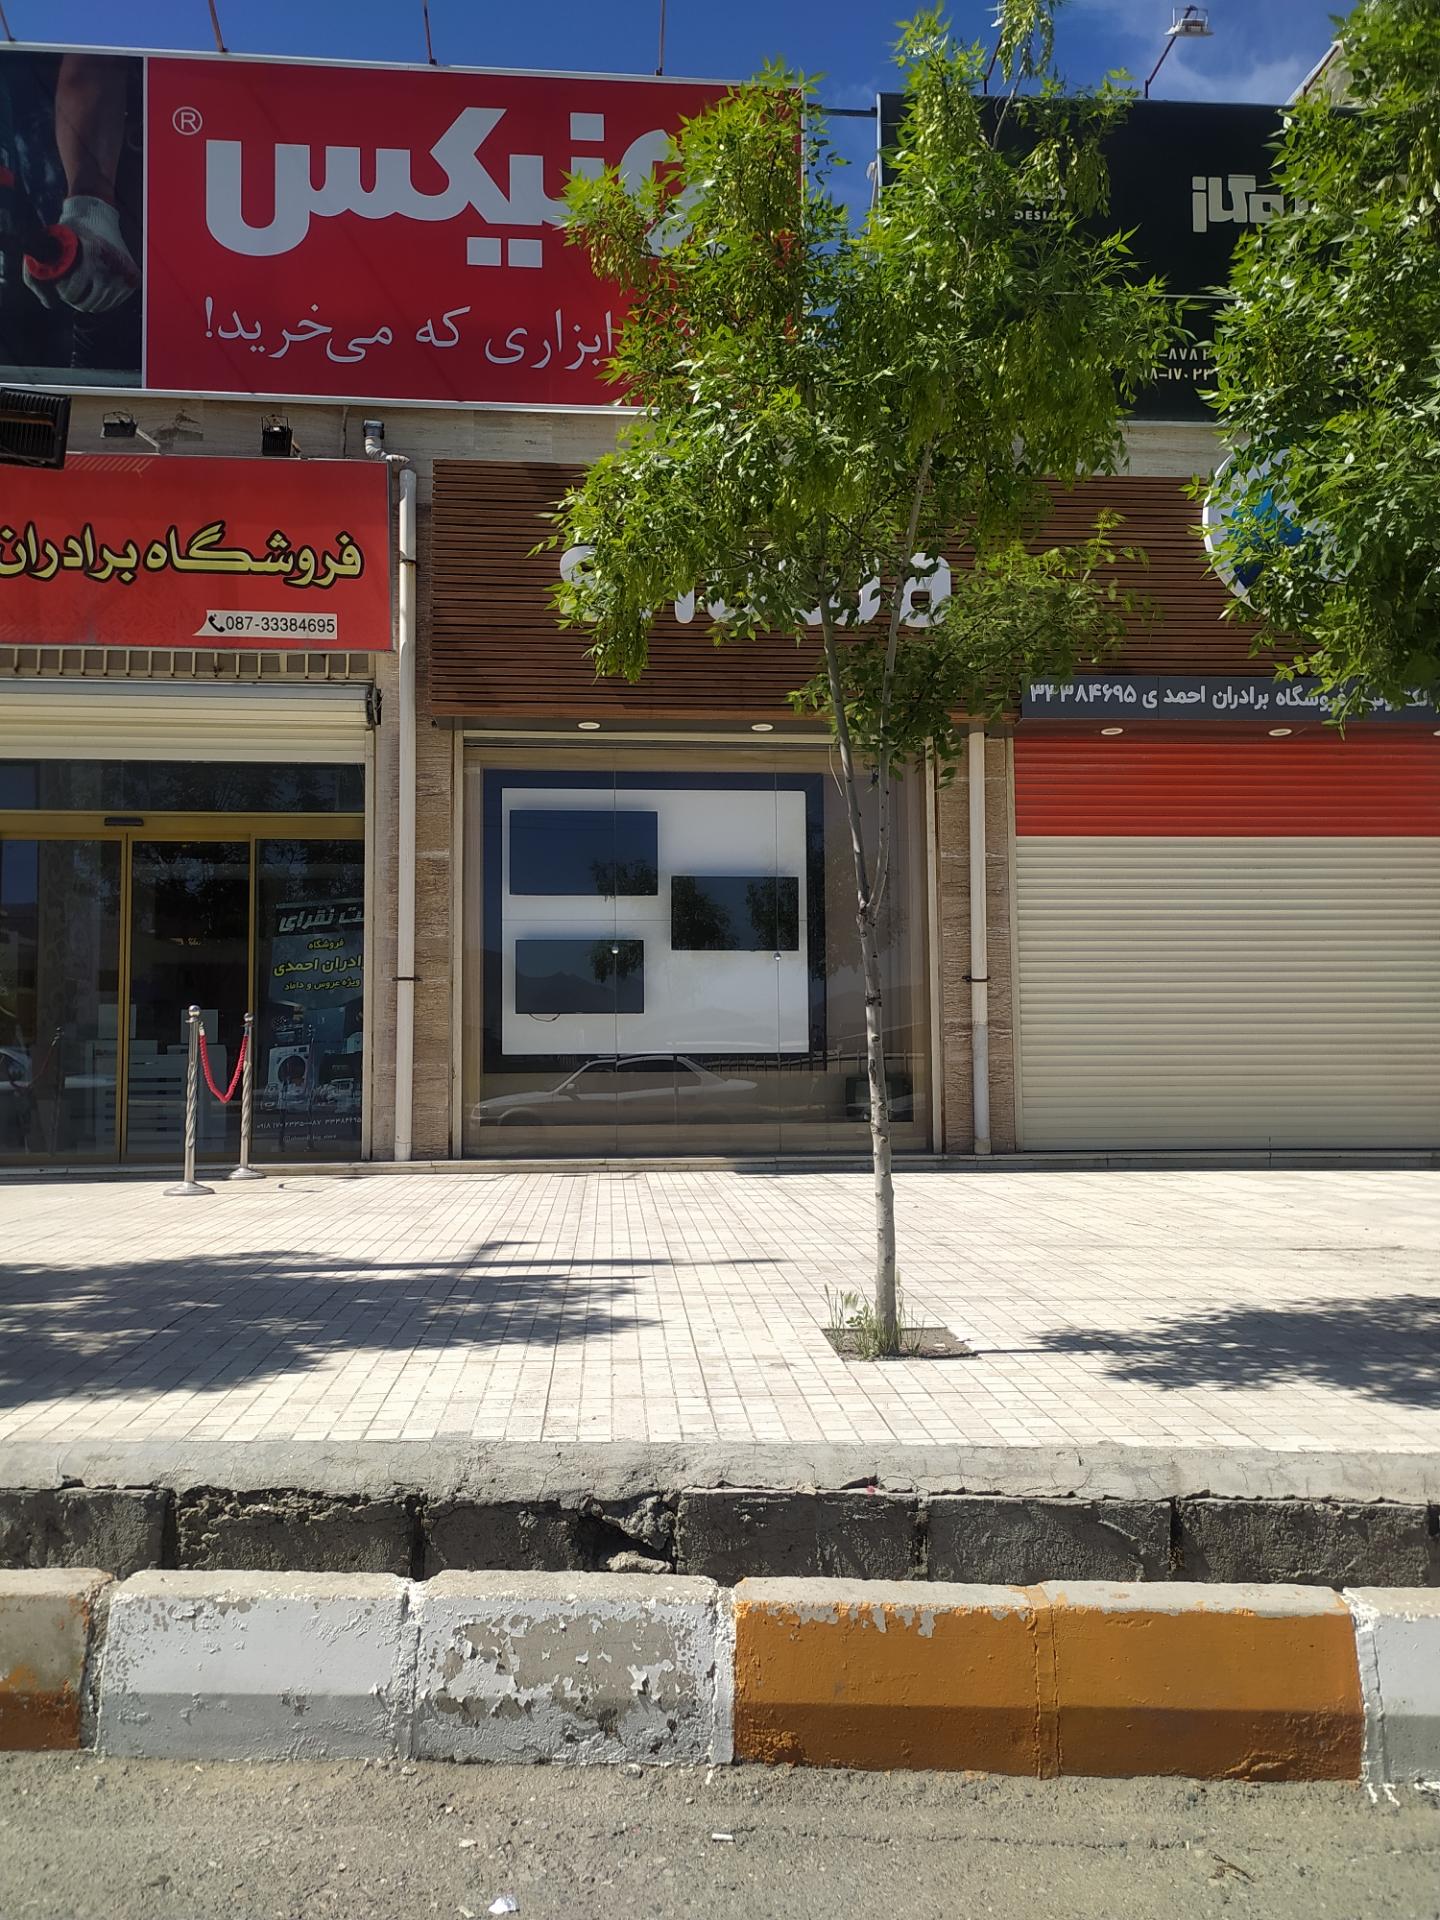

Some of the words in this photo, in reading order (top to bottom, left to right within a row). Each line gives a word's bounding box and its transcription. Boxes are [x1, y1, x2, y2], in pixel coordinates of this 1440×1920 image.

[205, 106, 727, 269] ونیکس
[415, 305, 470, 348] که
[485, 308, 613, 370] ابزاری
[0, 521, 139, 584] برادران
[145, 520, 363, 588] فروشگاه
[225, 614, 336, 634] 087-33384695
[1212, 685, 1270, 712] برادران
[308, 938, 345, 951] فروشگاه
[273, 958, 319, 977] احمدی
[322, 954, 364, 974] ادران
